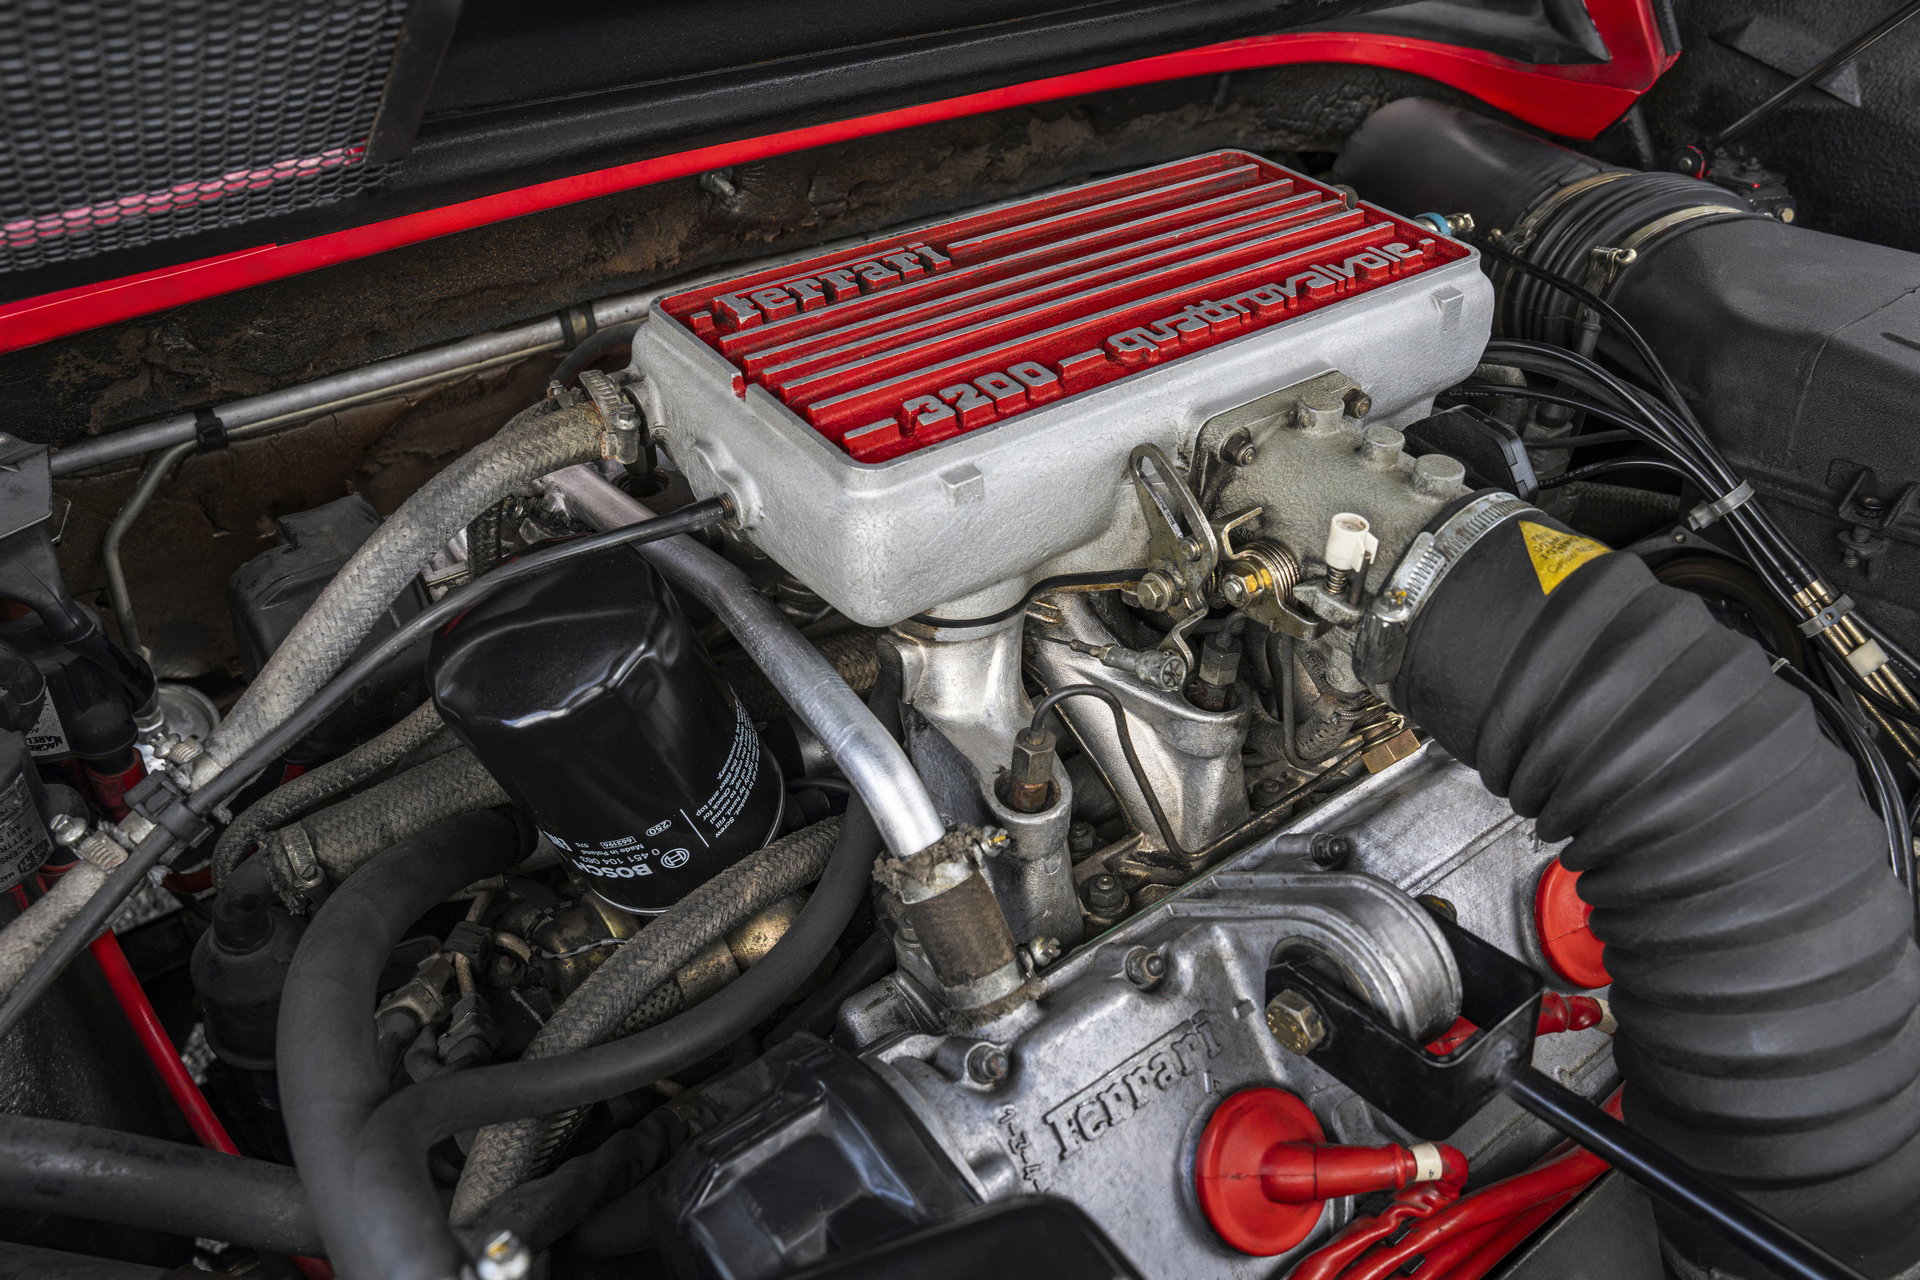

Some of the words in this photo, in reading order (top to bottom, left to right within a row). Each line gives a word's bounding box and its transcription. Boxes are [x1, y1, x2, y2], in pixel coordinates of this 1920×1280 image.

[713, 242, 951, 328] Ferrari
[902, 361, 1060, 432] 3200
[1107, 242, 1424, 355] quattrovalvole
[708, 790, 720, 806] and
[712, 788, 730, 810] Check
[730, 790, 737, 799] to
[734, 789, 750, 815] gasket.
[696, 804, 708, 817] top
[710, 799, 730, 824] normal
[725, 796, 740, 816] hand.
[703, 810, 713, 821] for
[716, 817, 726, 828] Fill
[648, 821, 669, 835] 250
[716, 817, 735, 838] Screw
[620, 843, 645, 853] Made
[602, 857, 624, 865] 104
[627, 852, 649, 863] 451
[571, 859, 653, 878] BOSCH
[1042, 1009, 1222, 1161] Ferrari
